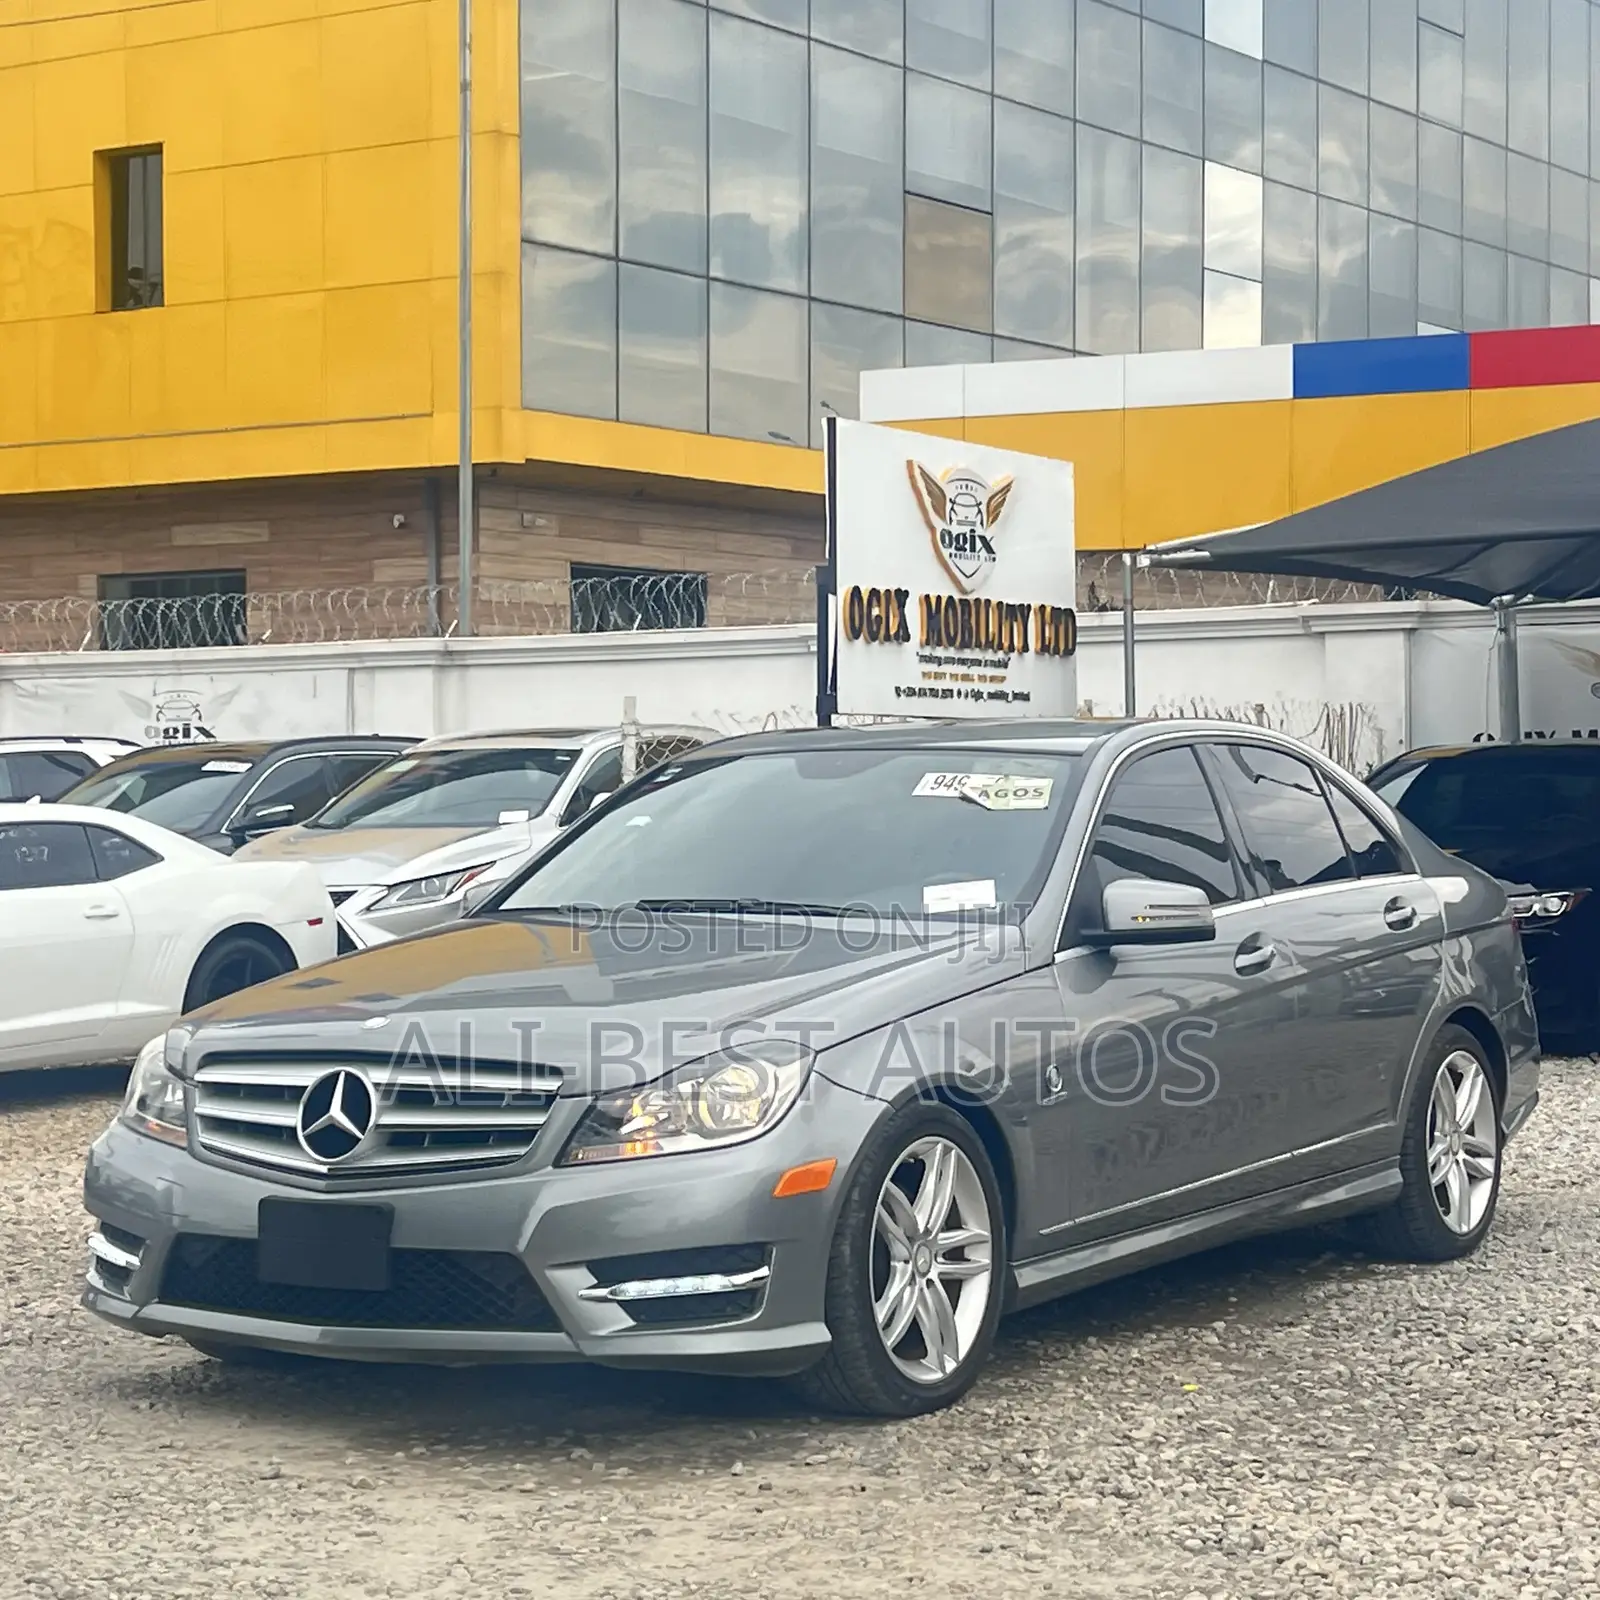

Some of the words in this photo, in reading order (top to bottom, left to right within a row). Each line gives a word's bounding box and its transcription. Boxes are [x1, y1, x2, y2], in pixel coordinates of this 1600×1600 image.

[843, 585, 911, 644] OGIX
[919, 593, 1031, 654] MOBILITY
[1033, 603, 1077, 656] LTD
